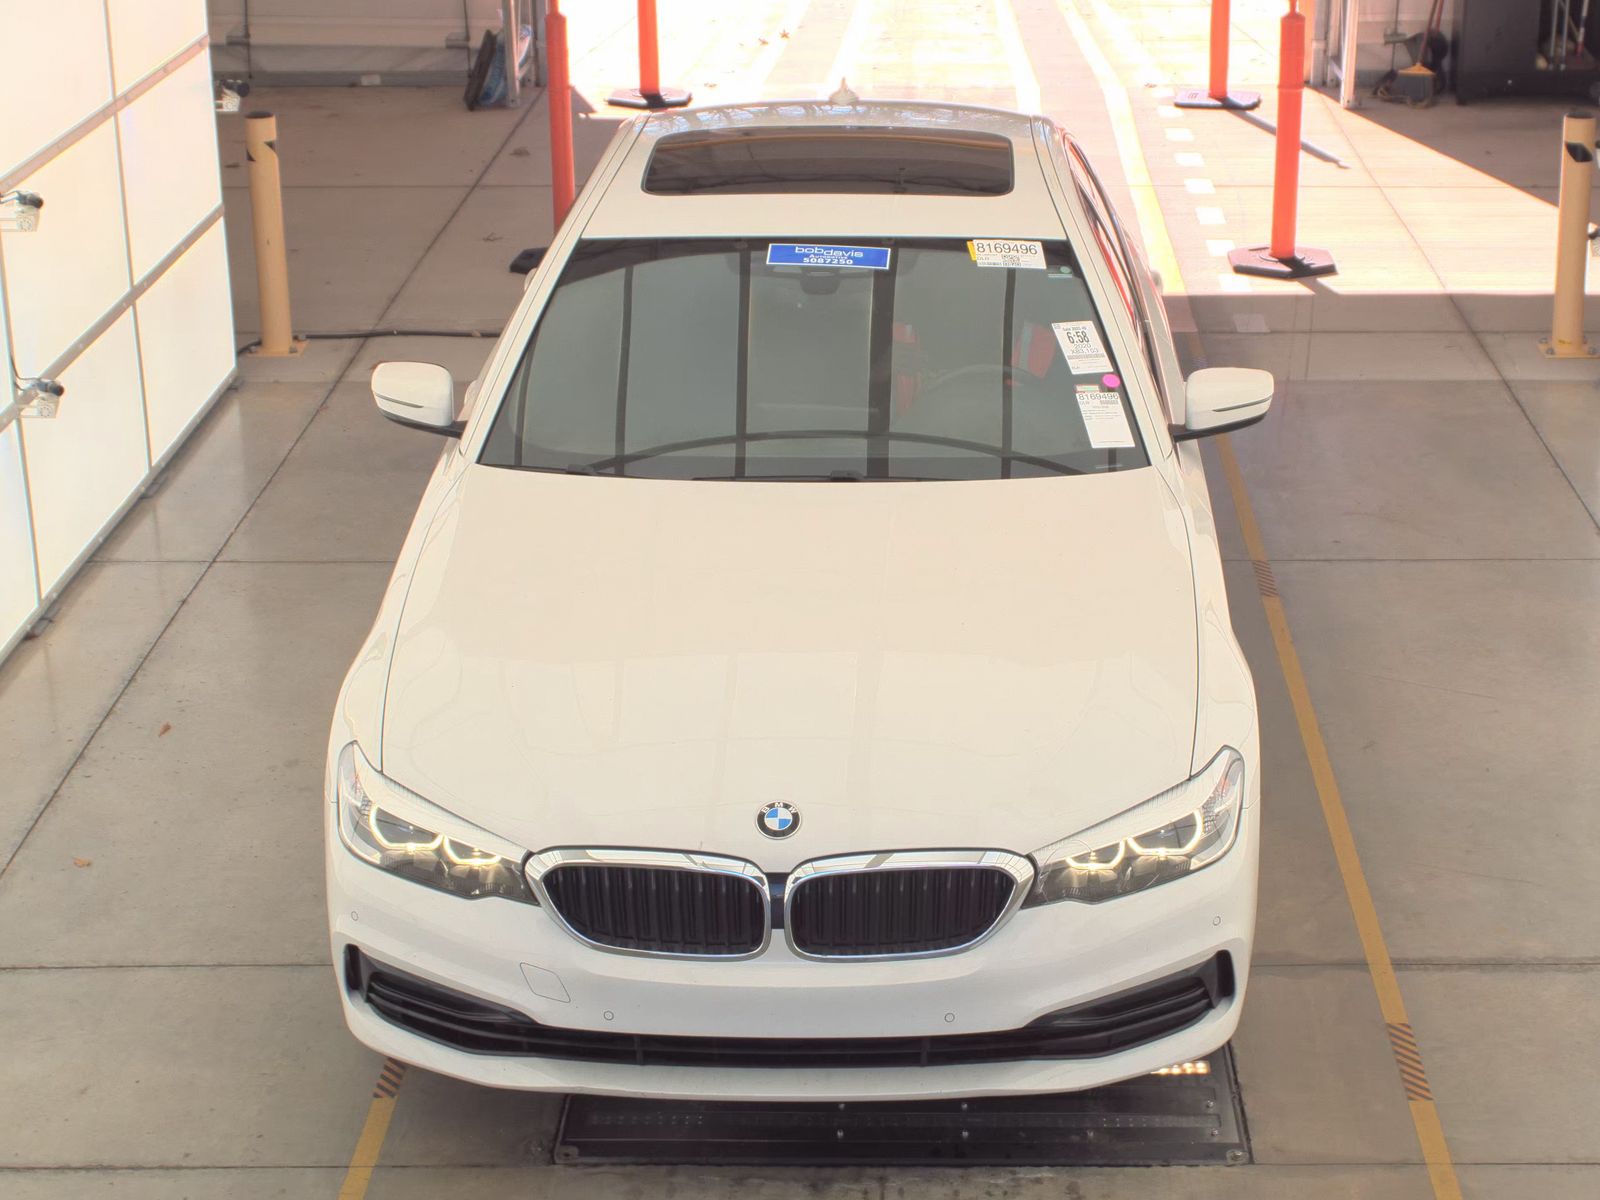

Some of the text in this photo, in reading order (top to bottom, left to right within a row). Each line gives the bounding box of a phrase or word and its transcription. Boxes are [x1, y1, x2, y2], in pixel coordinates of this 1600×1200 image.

[976, 242, 1038, 255] 8169496
[803, 257, 854, 265] 5087250
[1066, 330, 1090, 344] 6:58
[761, 802, 798, 814] BMW
